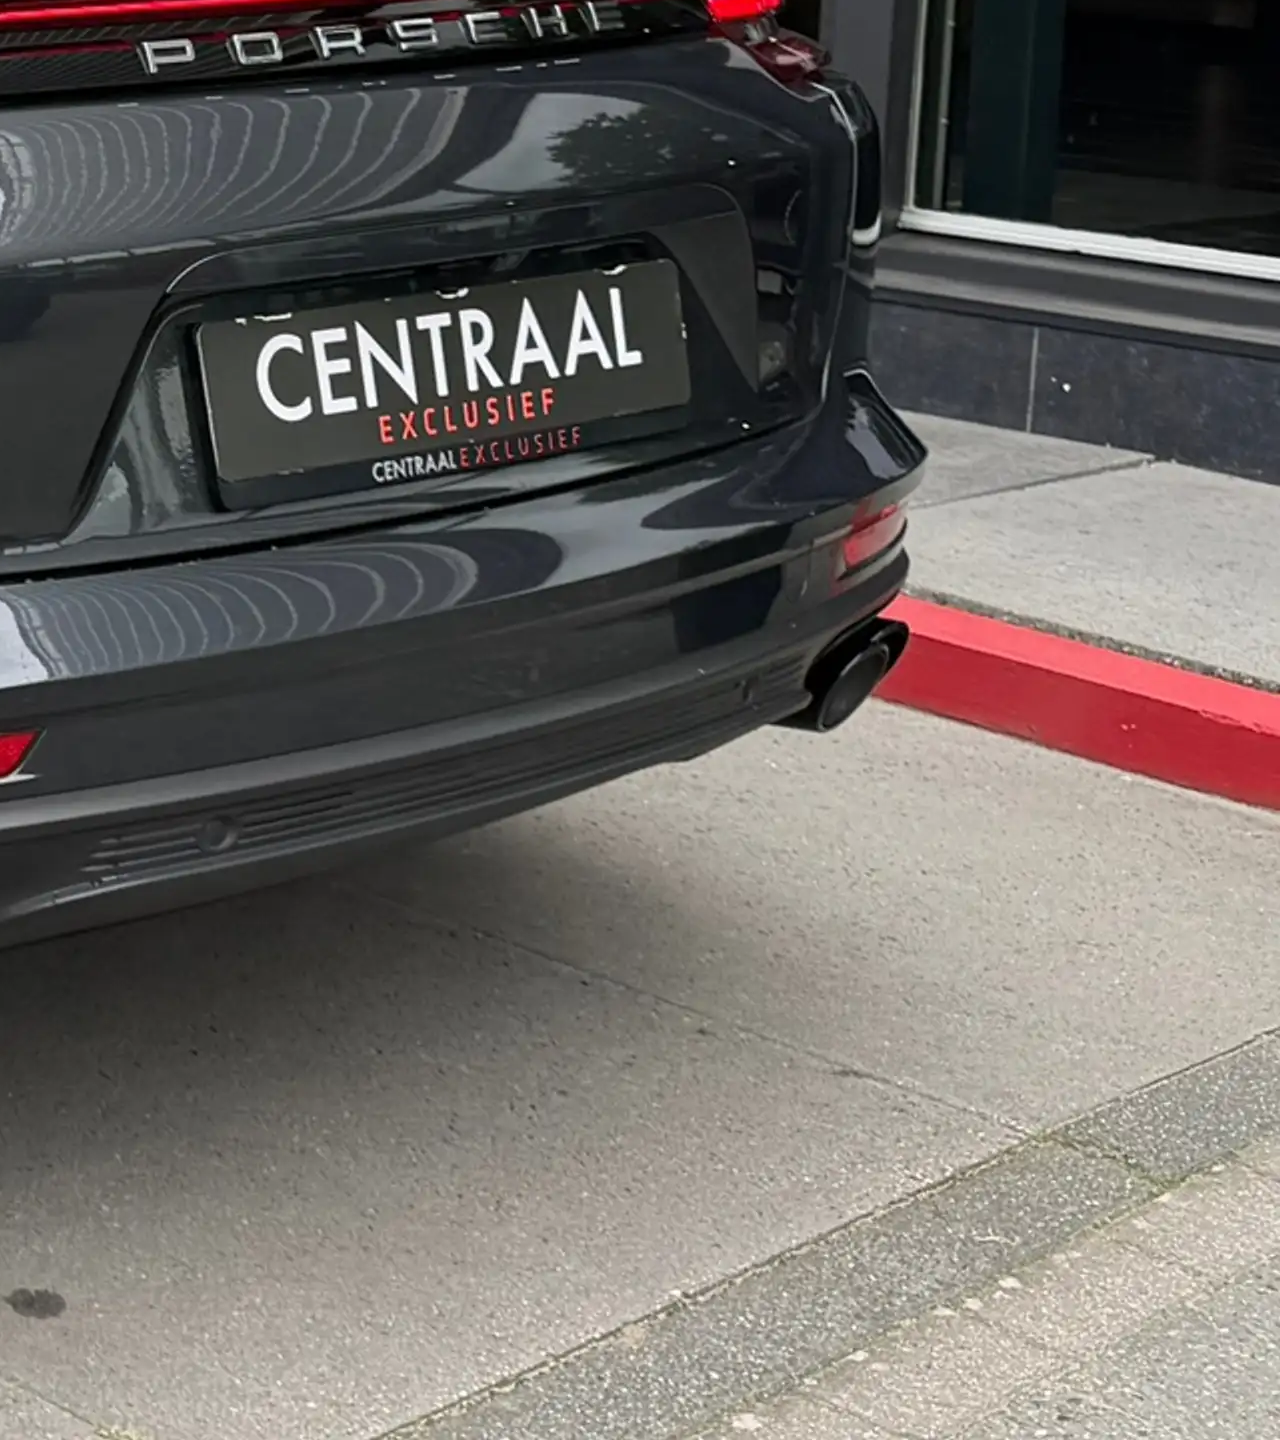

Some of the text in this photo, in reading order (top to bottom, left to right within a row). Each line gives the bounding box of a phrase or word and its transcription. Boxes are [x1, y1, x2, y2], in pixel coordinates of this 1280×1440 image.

[137, 0, 626, 74] PORSCHE
[255, 287, 643, 422] CENTRAAL
[379, 388, 556, 444] EXCLUSIEF
